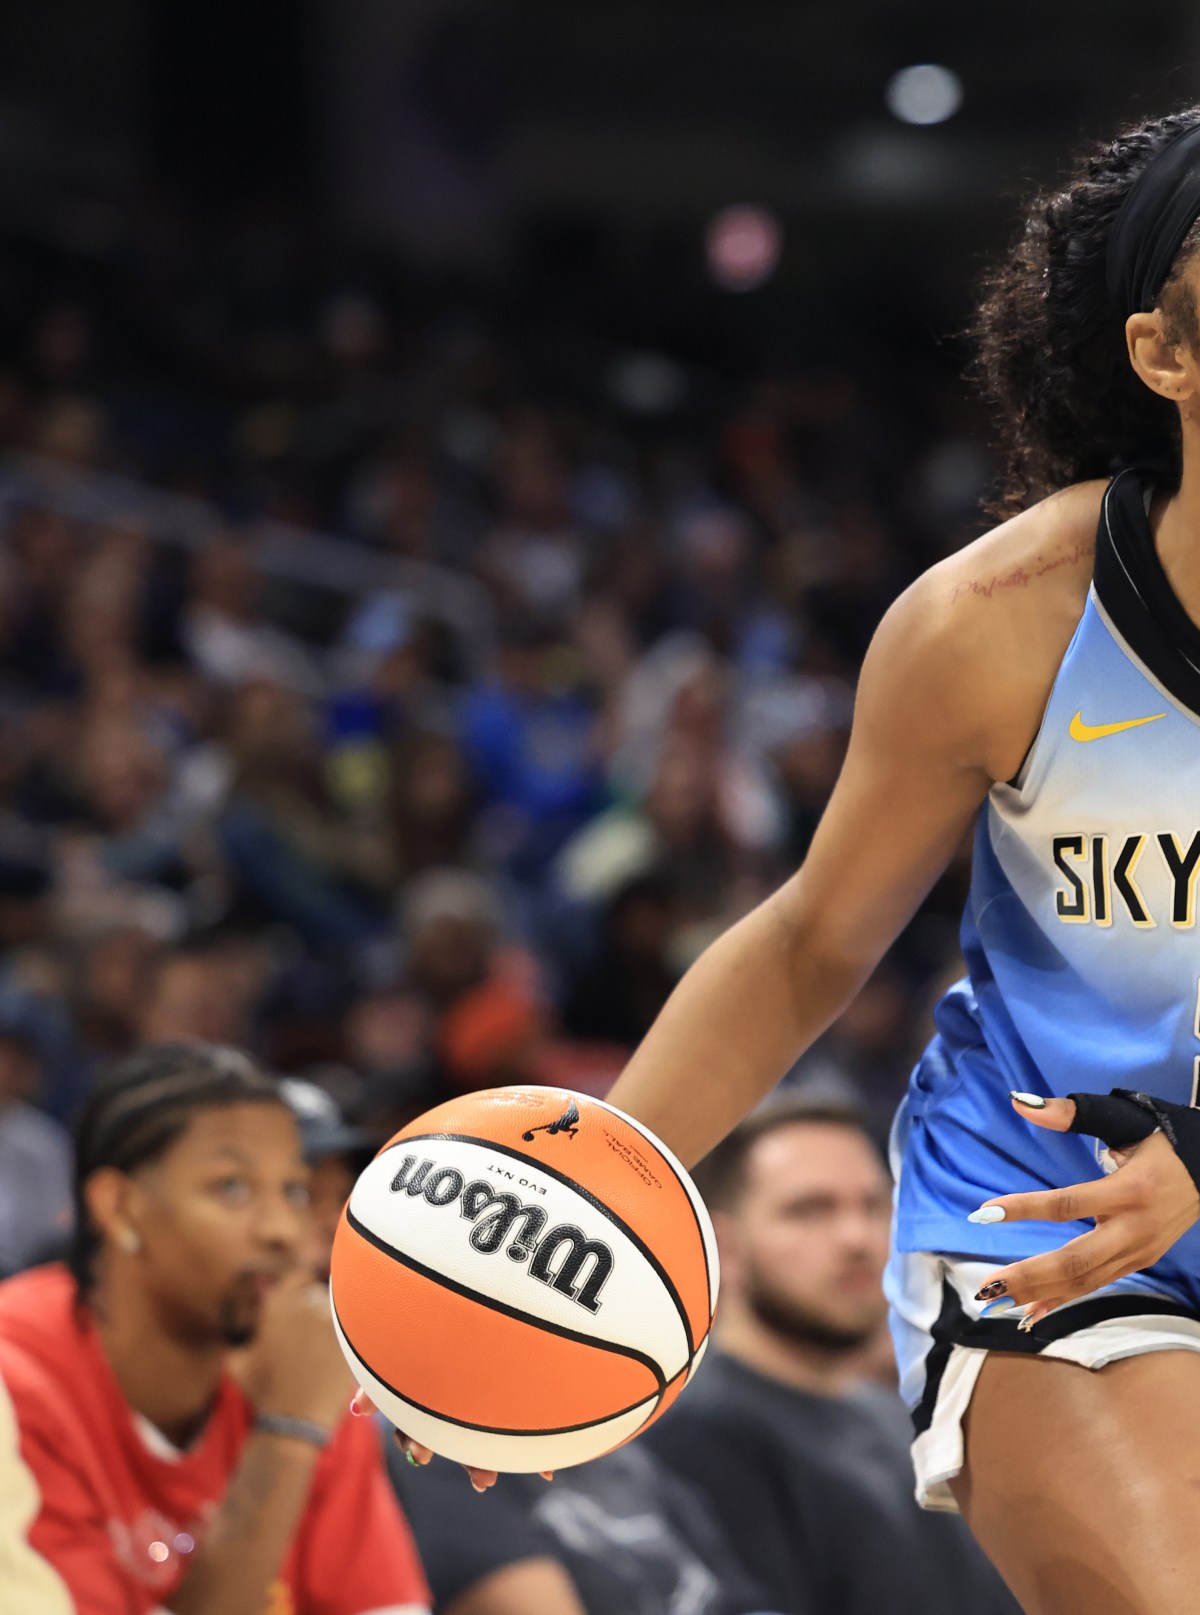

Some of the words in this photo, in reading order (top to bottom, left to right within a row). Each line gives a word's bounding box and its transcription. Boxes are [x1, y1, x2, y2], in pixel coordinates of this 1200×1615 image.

[486, 1164, 515, 1180] NXT
[605, 1139, 652, 1186] OFFICIAL
[518, 1178, 548, 1195] EVO
[389, 1154, 615, 1316] Wilson
